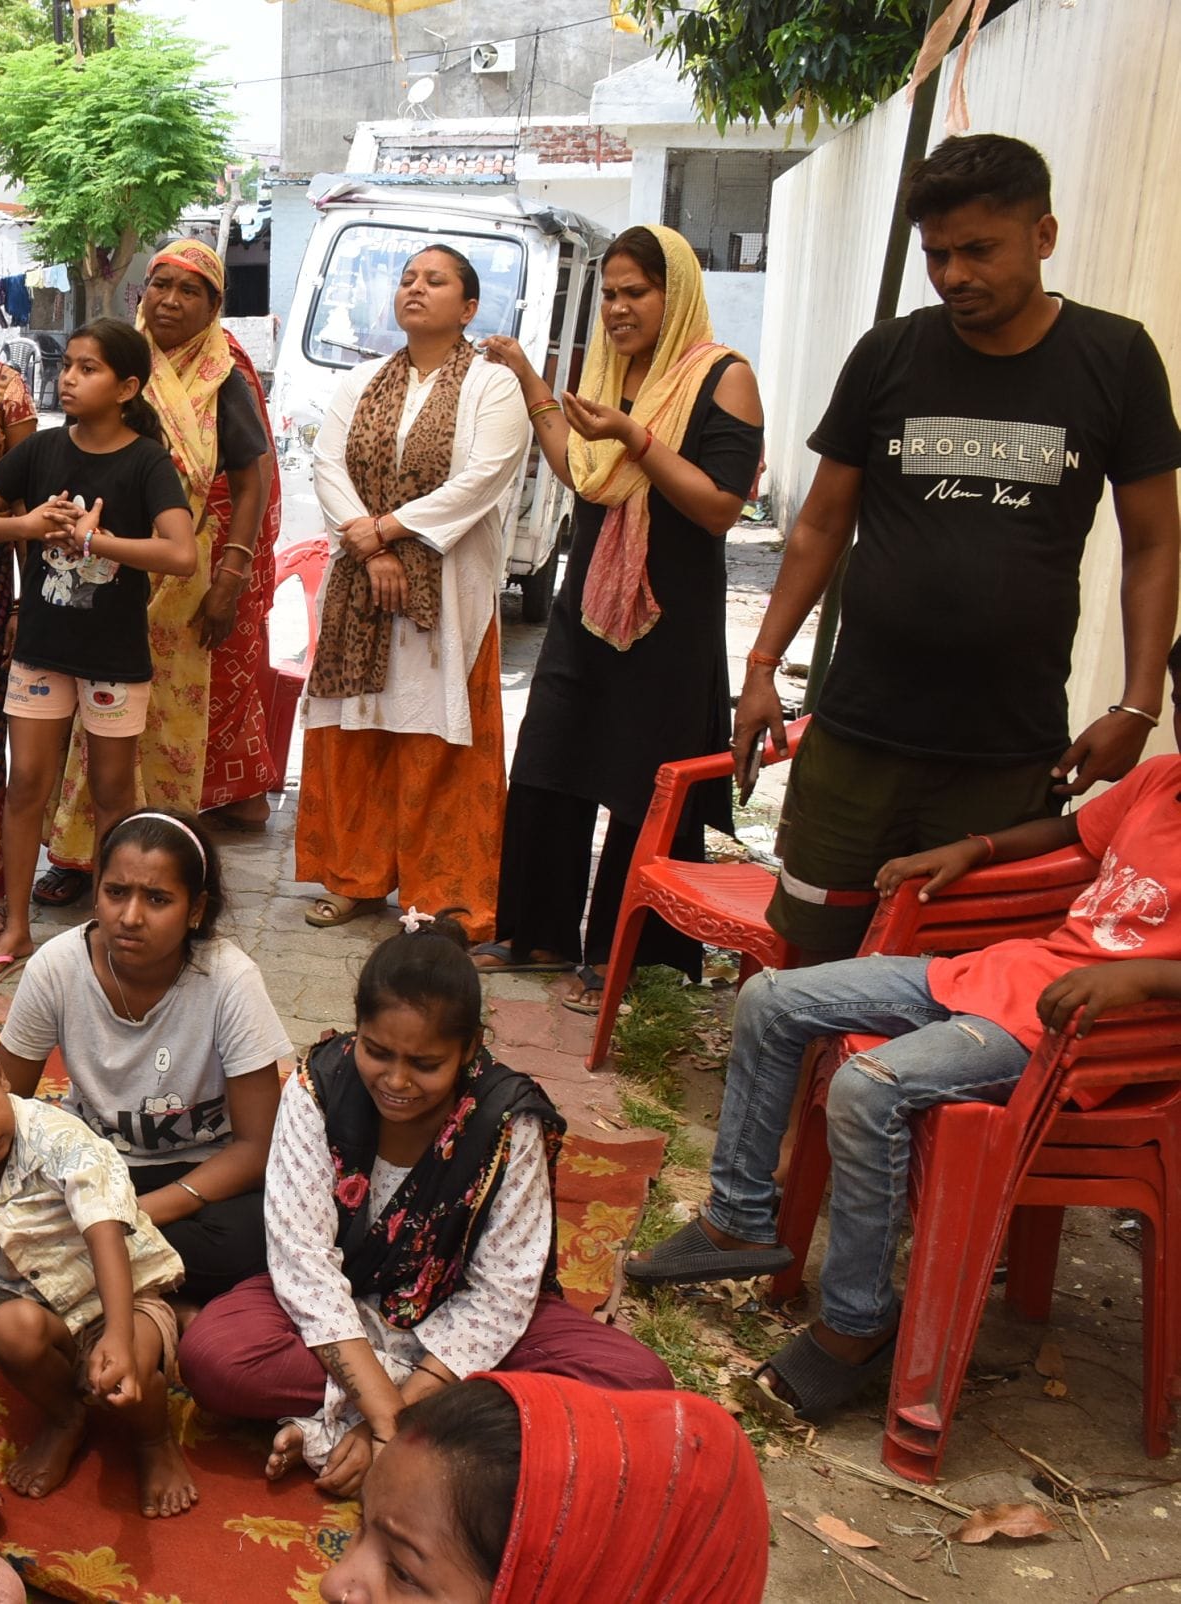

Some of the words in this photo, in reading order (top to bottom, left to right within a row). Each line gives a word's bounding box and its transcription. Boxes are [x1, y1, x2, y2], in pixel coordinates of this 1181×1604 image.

[888, 438, 1080, 469] BROOKLYN
[924, 478, 983, 501] New
[991, 482, 1032, 509] York
[158, 1053, 167, 1066] Z
[81, 1094, 226, 1149] IKE
